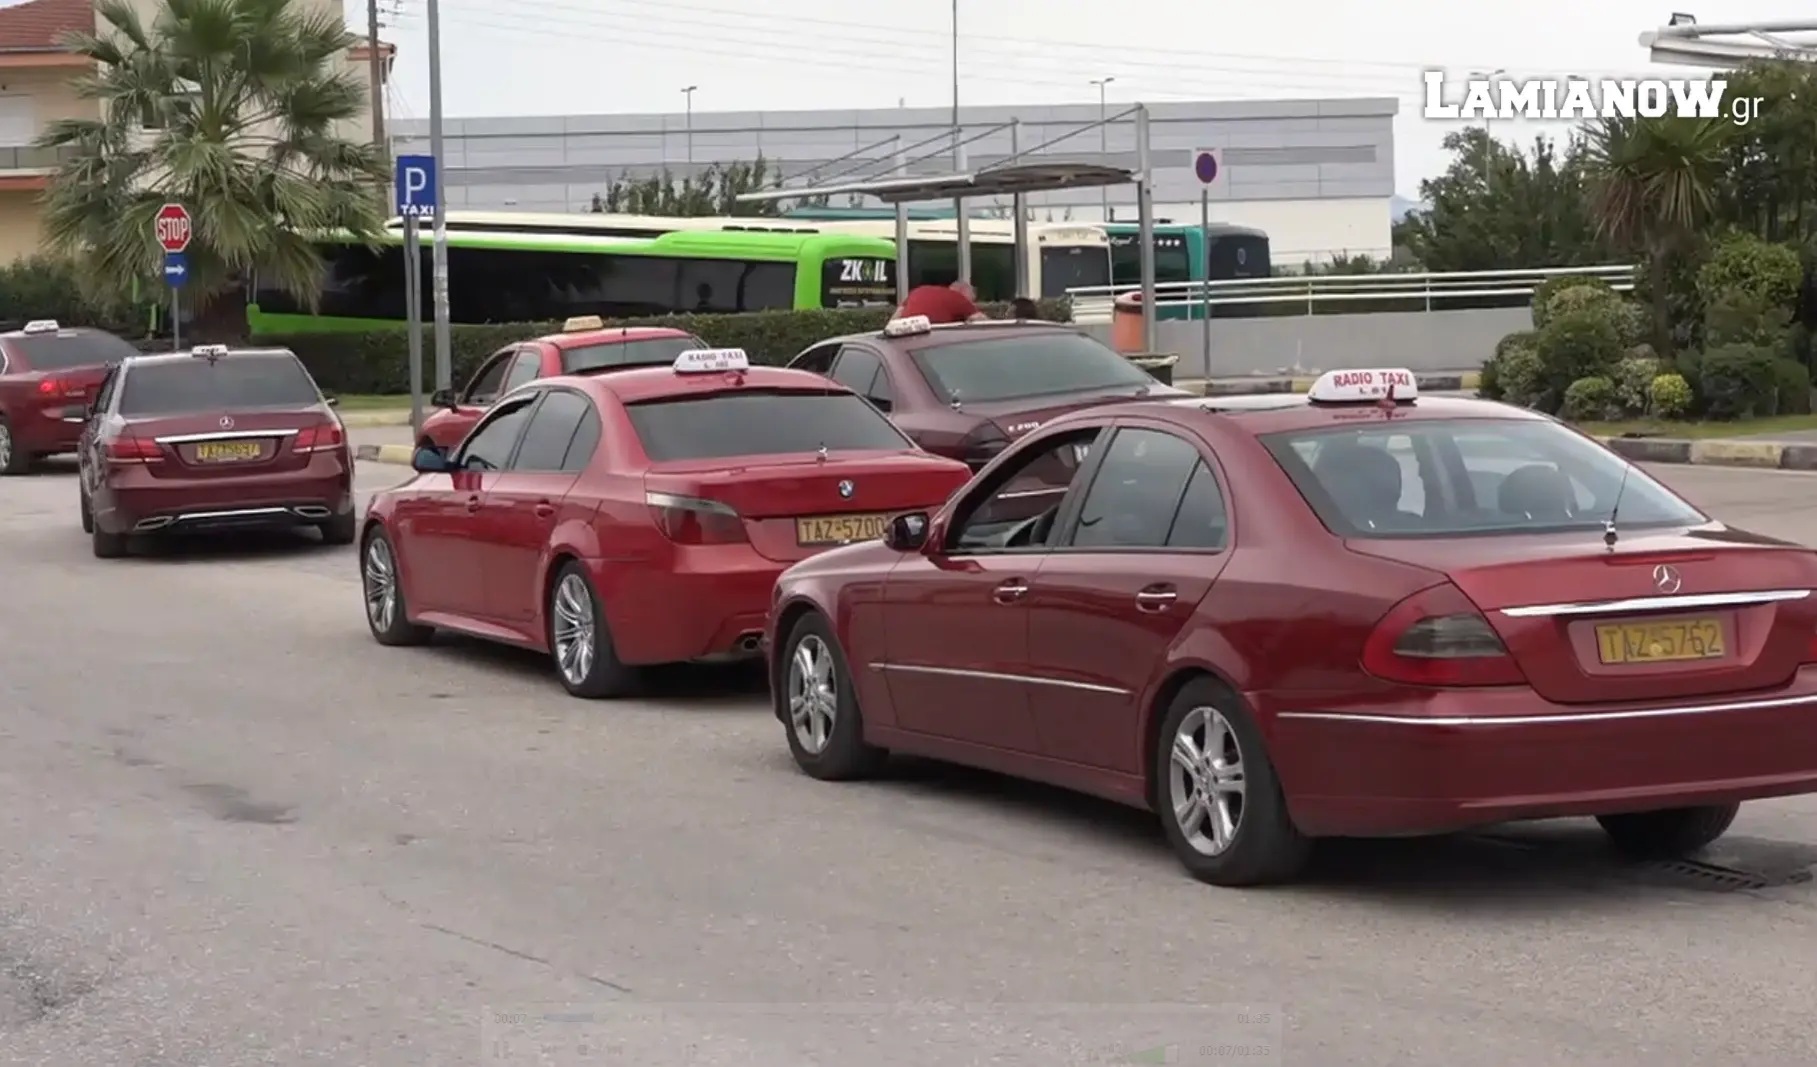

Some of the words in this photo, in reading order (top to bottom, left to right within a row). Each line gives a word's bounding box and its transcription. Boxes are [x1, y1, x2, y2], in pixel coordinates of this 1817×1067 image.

[404, 167, 427, 204] P
[400, 204, 435, 216] TAXI
[158, 217, 188, 241] STOP
[1333, 372, 1373, 388] RADIO
[1379, 372, 1410, 387] TAXI
